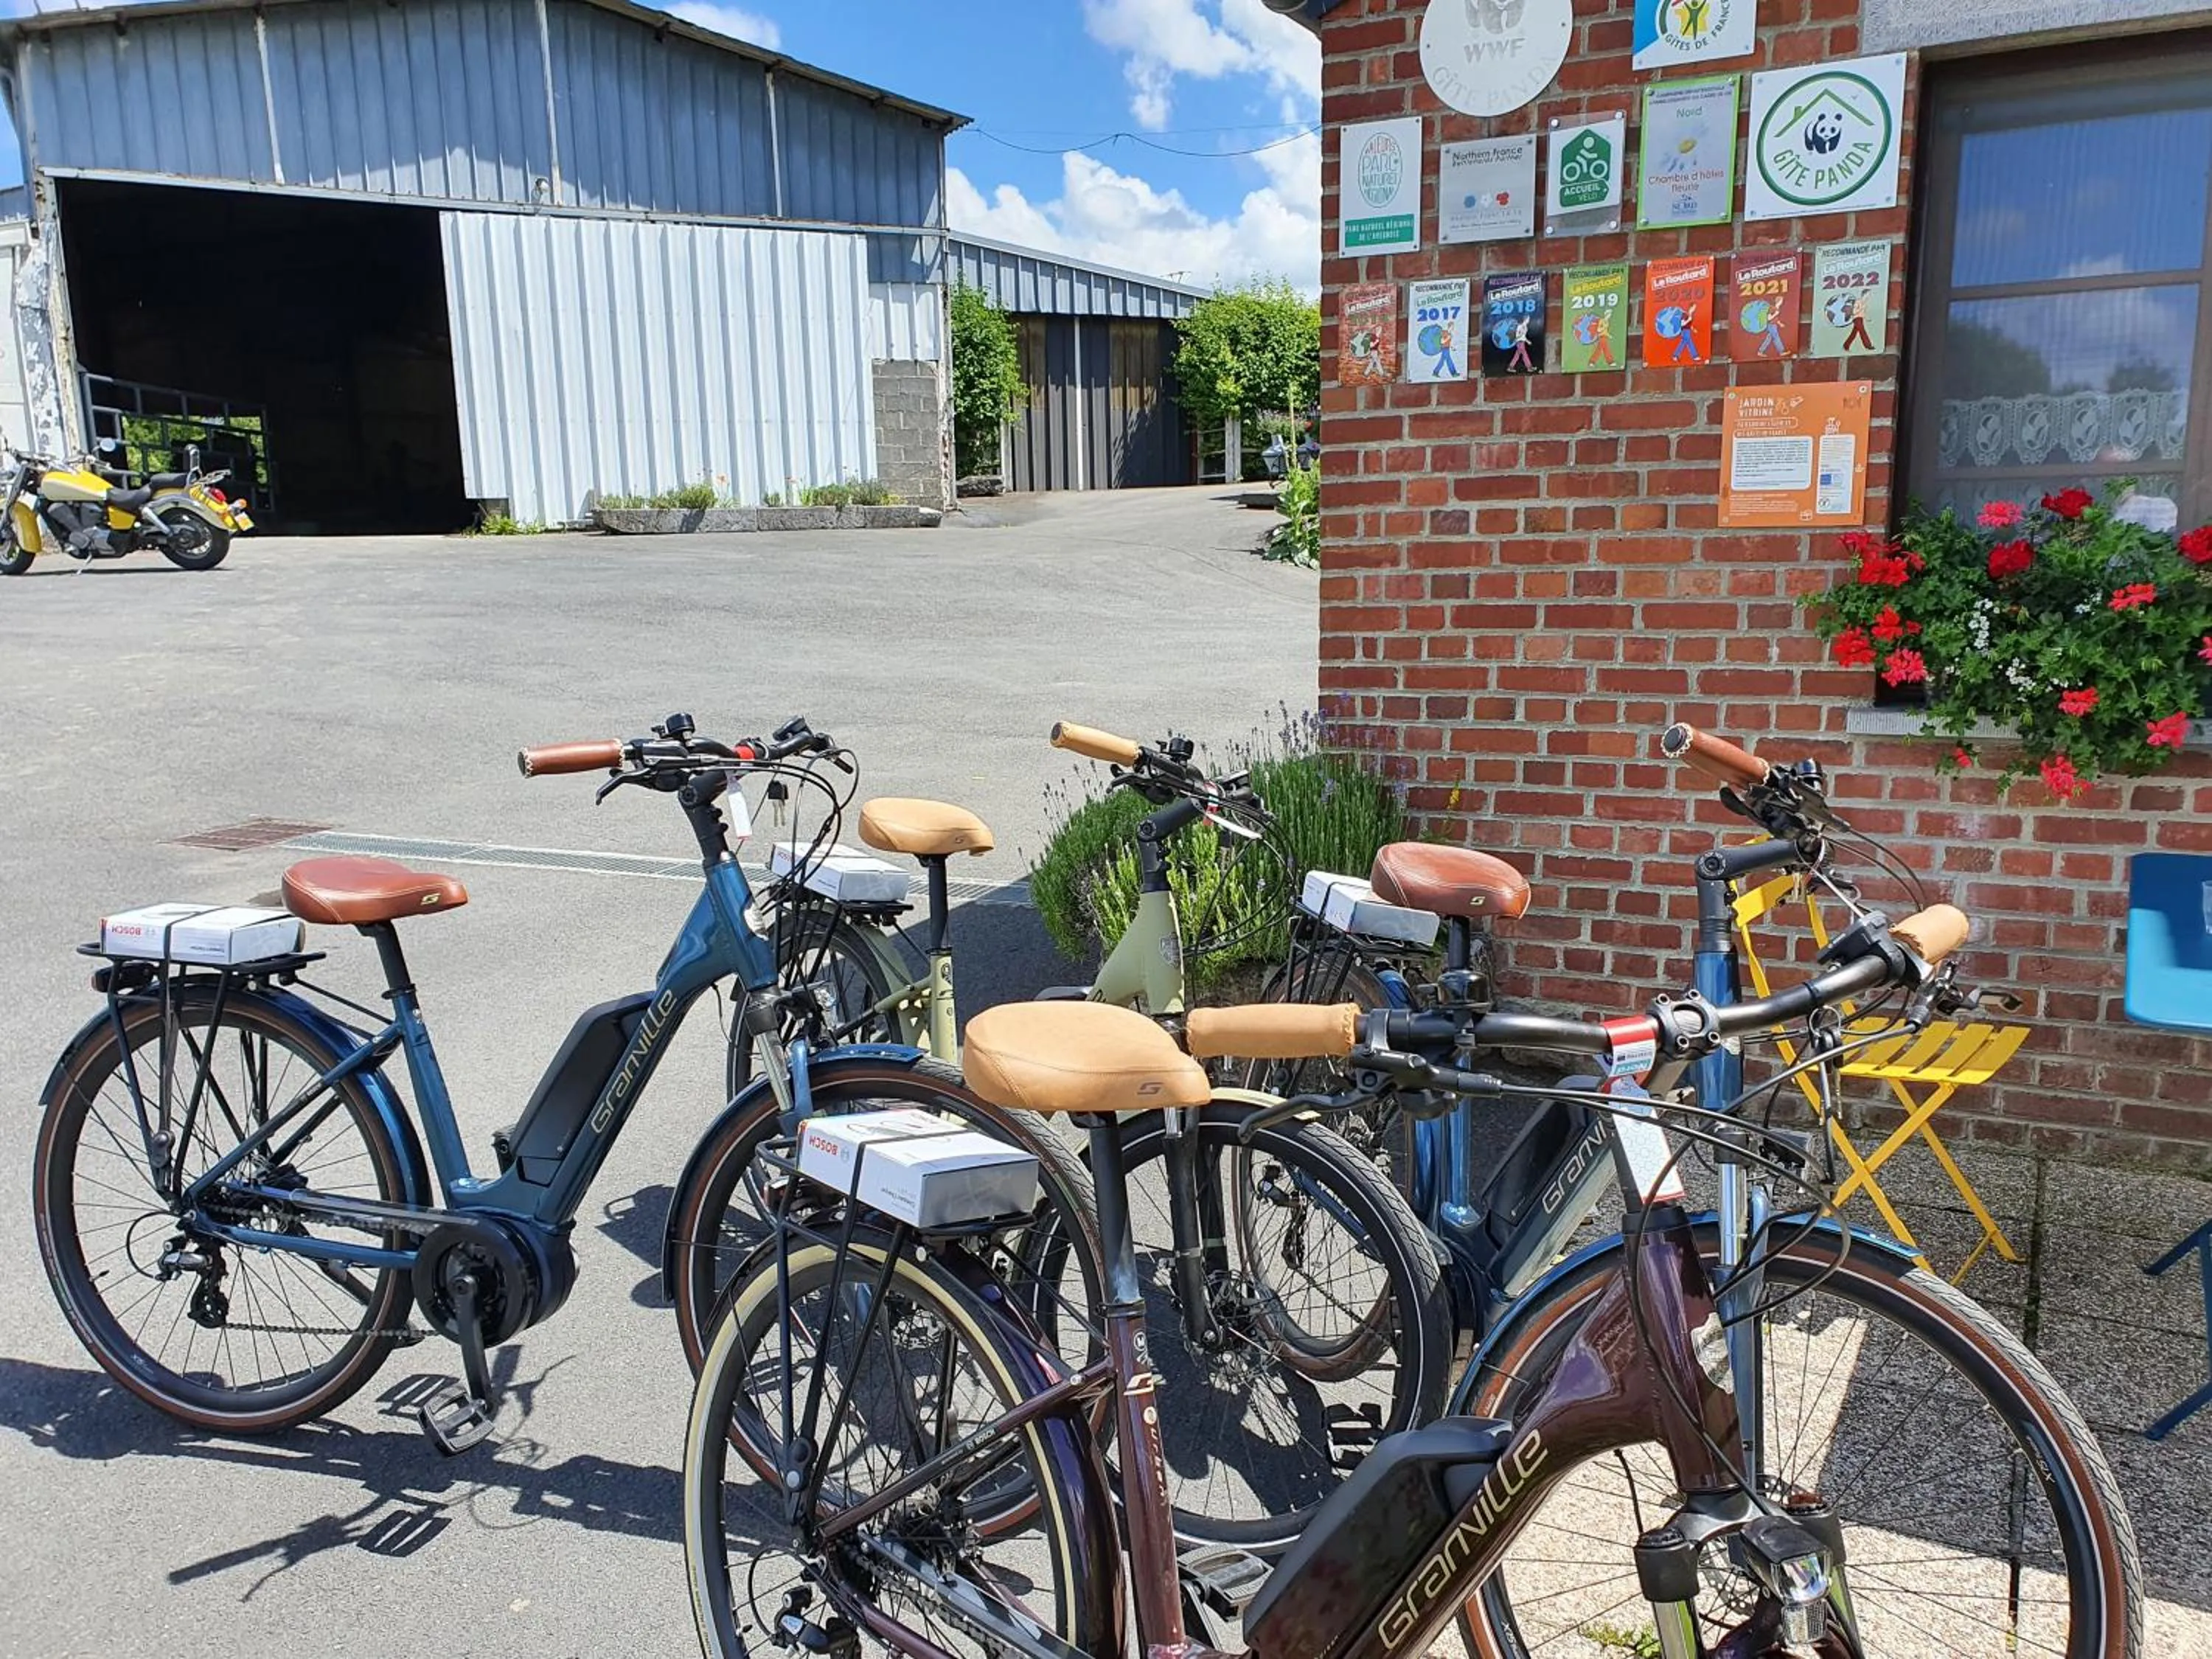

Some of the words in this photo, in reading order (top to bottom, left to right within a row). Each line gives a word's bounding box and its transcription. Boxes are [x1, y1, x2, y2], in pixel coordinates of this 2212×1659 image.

[1464, 38, 1526, 63] WWF
[1695, 38, 1709, 49] DE
[1676, 106, 1703, 118] Nord
[1773, 149, 1810, 187] GÎTE
[1815, 142, 1874, 189] PANDA
[1649, 173, 1689, 185] Chambre
[1564, 183, 1601, 196] ACCUEIL
[1837, 252, 1882, 271] Routard
[1666, 267, 1707, 285] Routard
[1739, 272, 1750, 281] Le
[1751, 260, 1794, 279] Routard
[1582, 275, 1621, 291] Routard
[1739, 279, 1788, 296] 2021
[1822, 271, 1879, 290] 2022
[1427, 290, 1464, 305] Routard
[1502, 282, 1540, 299] Routard
[1490, 299, 1536, 316] 2018
[1571, 293, 1618, 310] 2019
[1416, 306, 1461, 322] 2017
[1739, 397, 1774, 408] JARDIN
[111, 925, 142, 936] BOSCH
[809, 1135, 839, 1156] BOSCH
